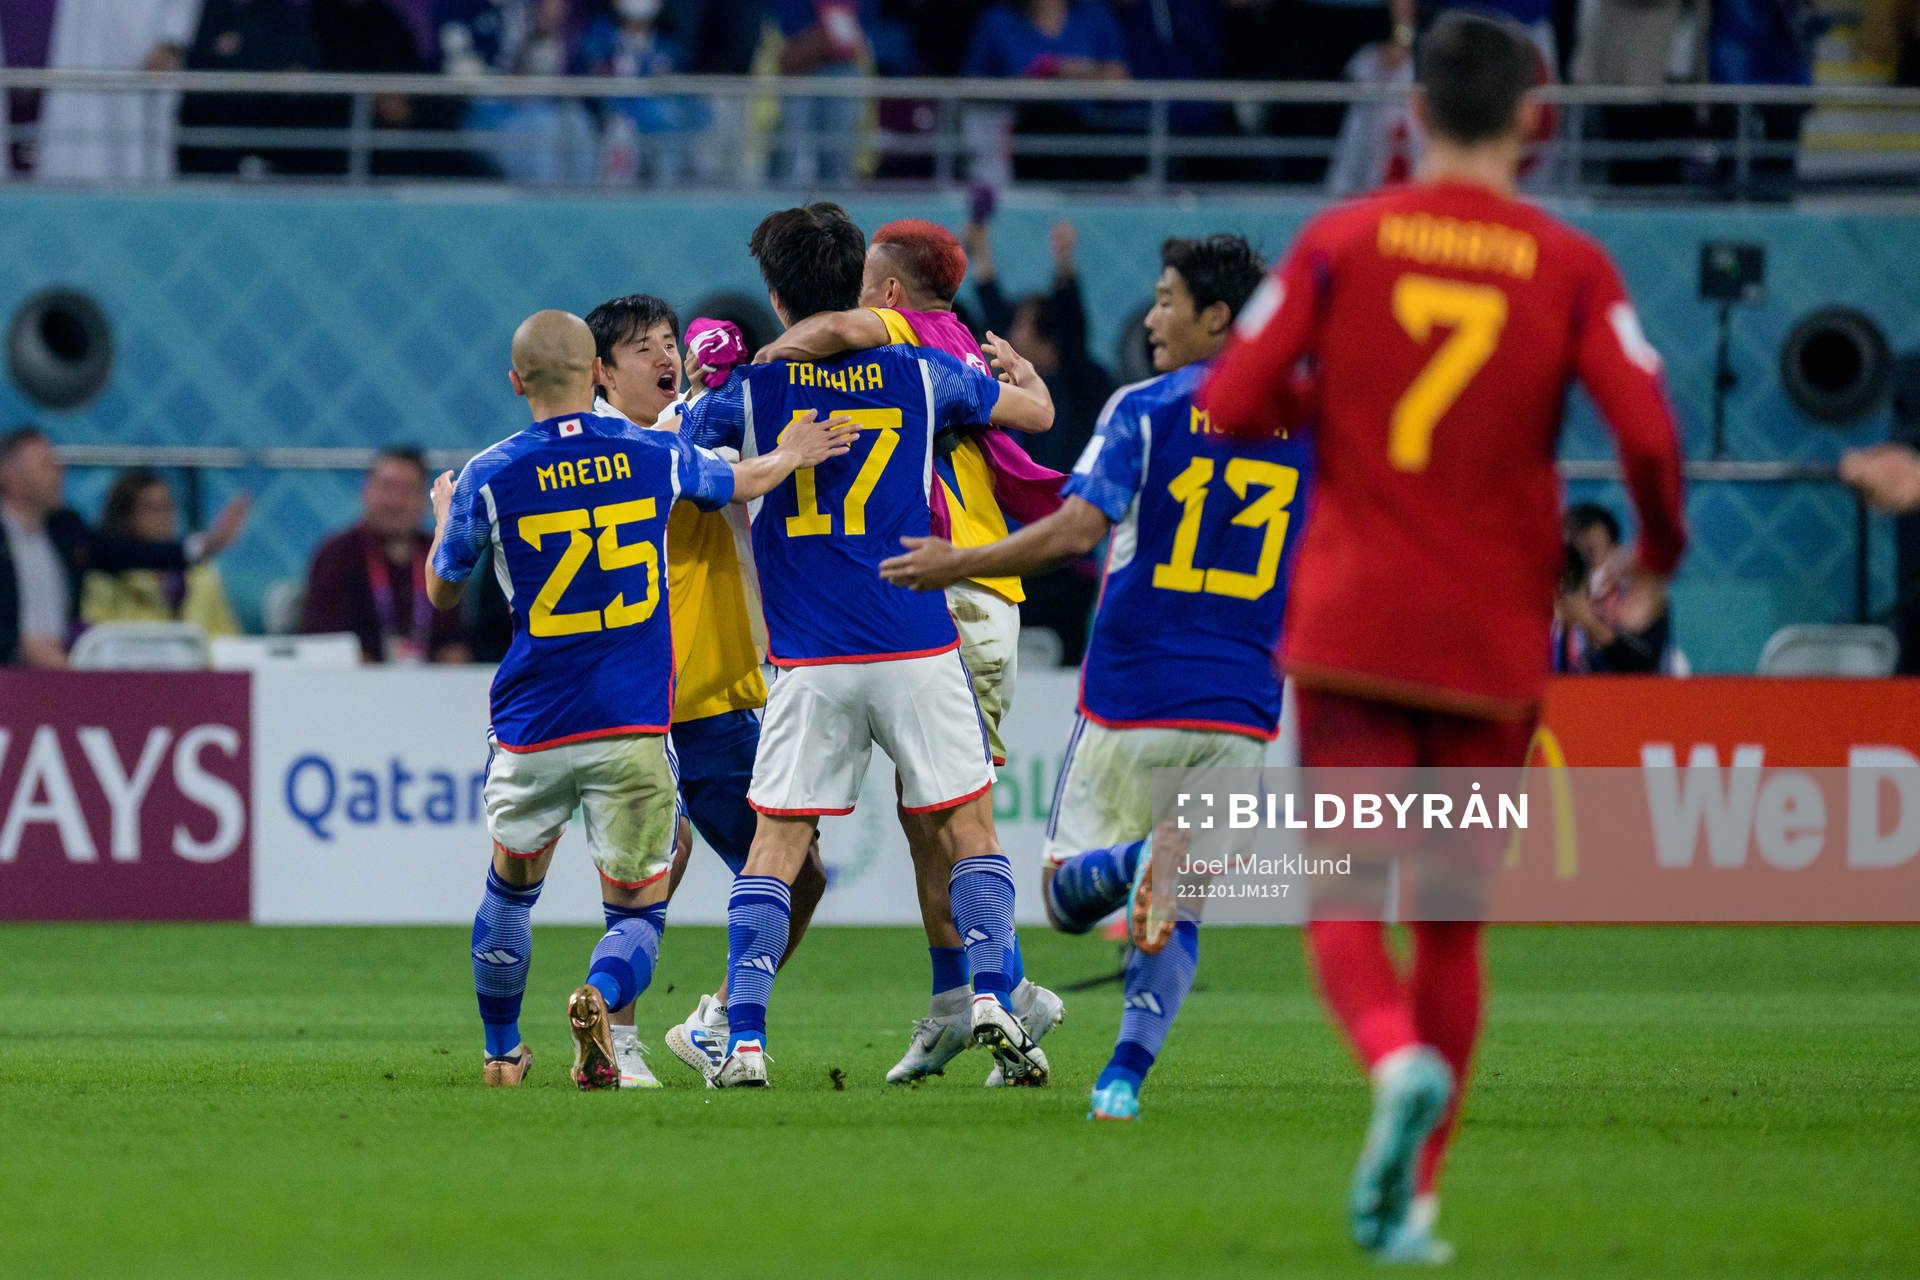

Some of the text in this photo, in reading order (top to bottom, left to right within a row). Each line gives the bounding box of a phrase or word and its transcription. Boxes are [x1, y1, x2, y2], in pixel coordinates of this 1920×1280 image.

[786, 362, 884, 392] TANAKA
[1387, 275, 1508, 473] 7
[536, 452, 632, 491] MAEDA
[776, 407, 903, 538] 17
[1152, 456, 1300, 601] 13
[517, 496, 660, 638] 25
[0, 722, 246, 864] AYS
[284, 753, 486, 842] Qatar
[1639, 741, 1828, 870] We
